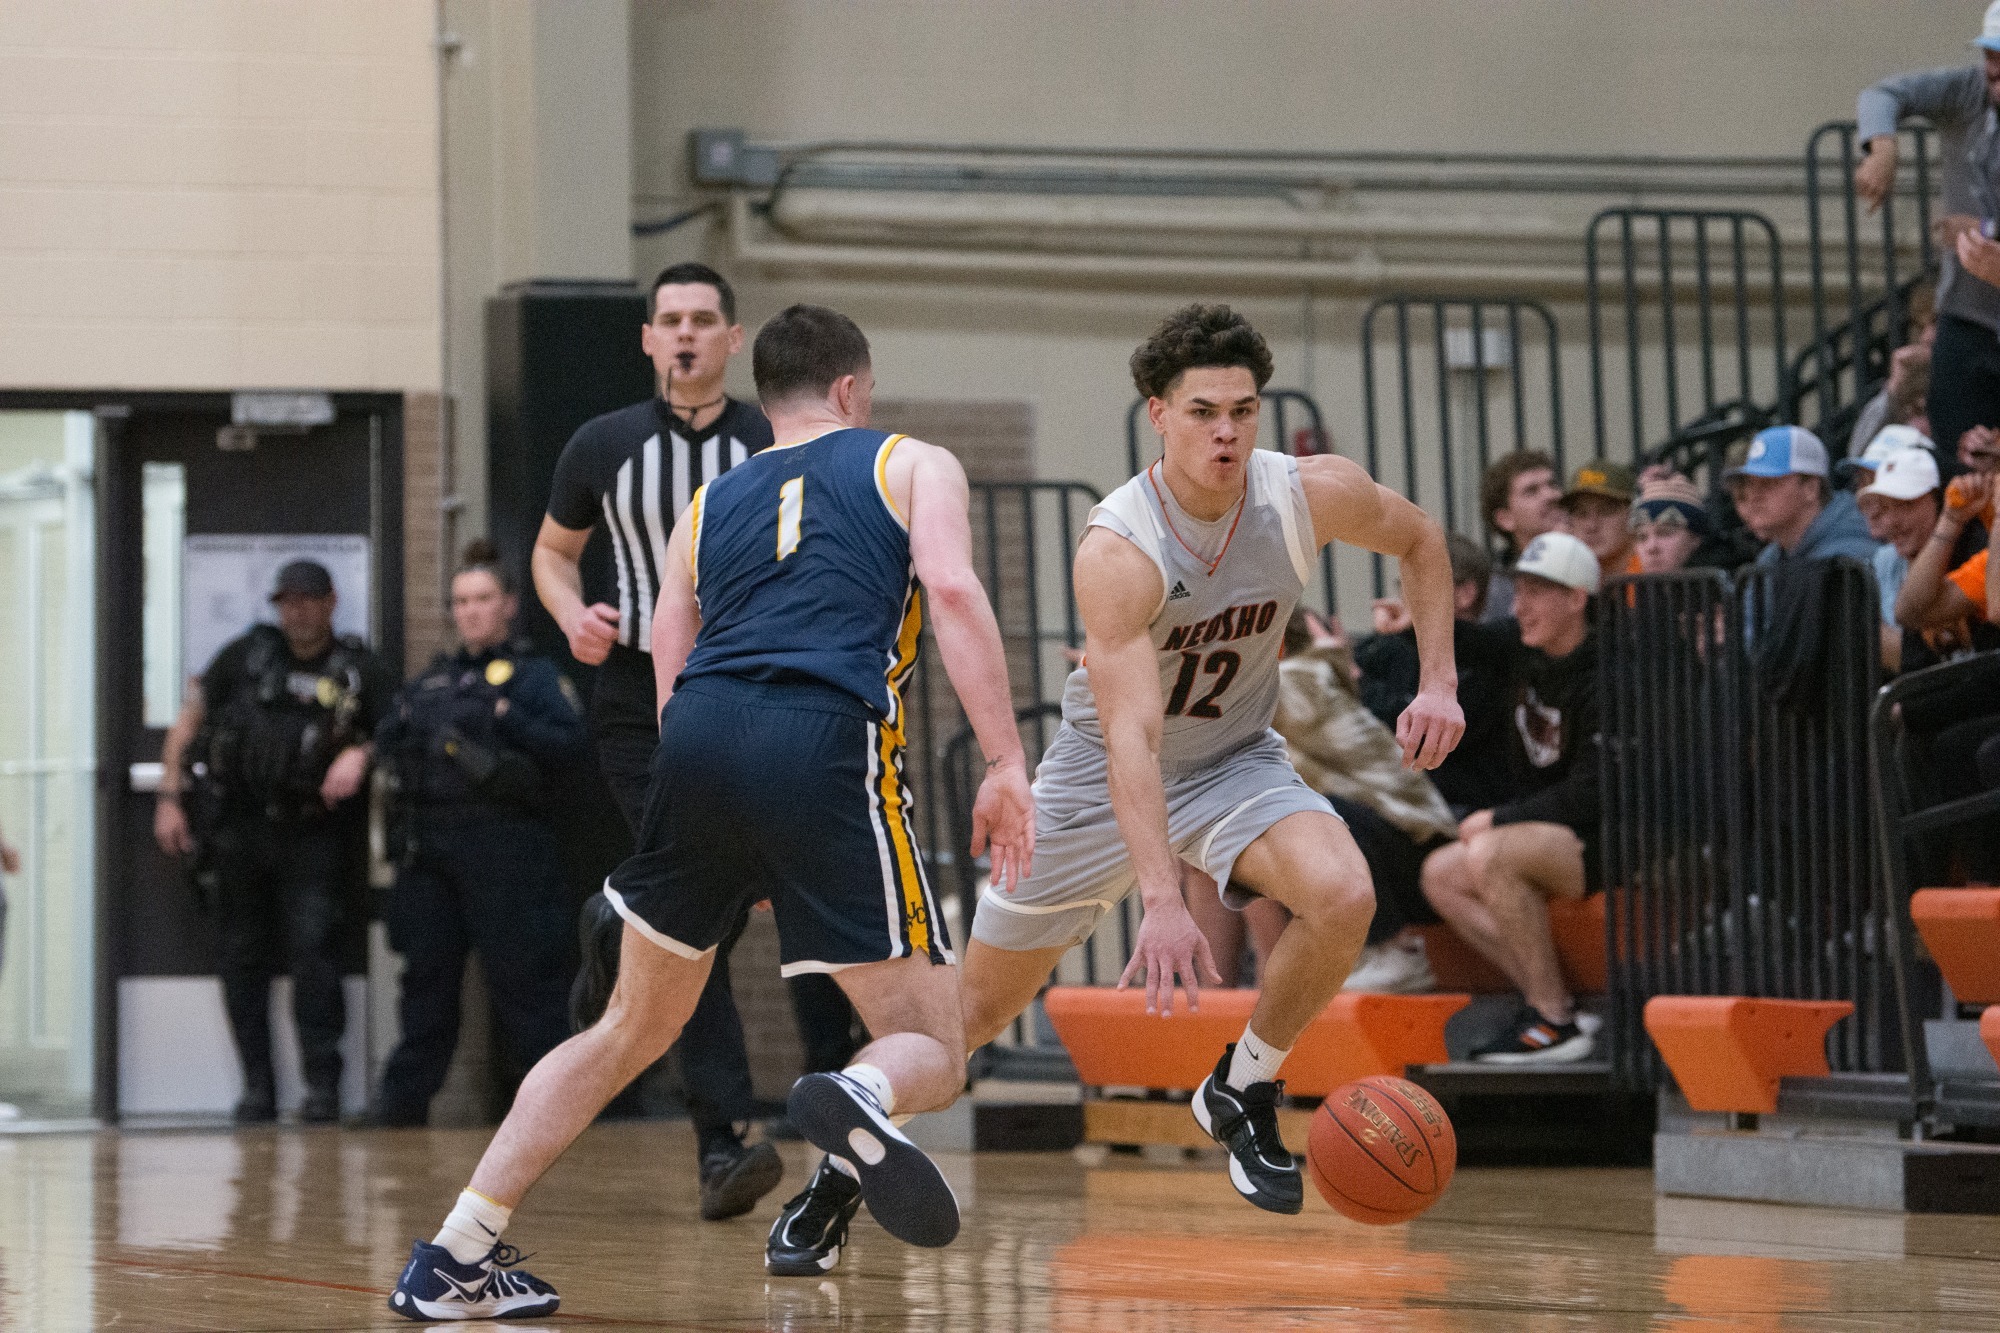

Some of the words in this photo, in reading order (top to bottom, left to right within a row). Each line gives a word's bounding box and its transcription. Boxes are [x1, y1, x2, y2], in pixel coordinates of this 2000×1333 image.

[776, 474, 804, 561] 1
[1159, 600, 1278, 651] NEOSHO
[1168, 591, 1191, 601] adidas
[1164, 650, 1242, 719] 12
[1342, 1088, 1424, 1169] SPALDING
